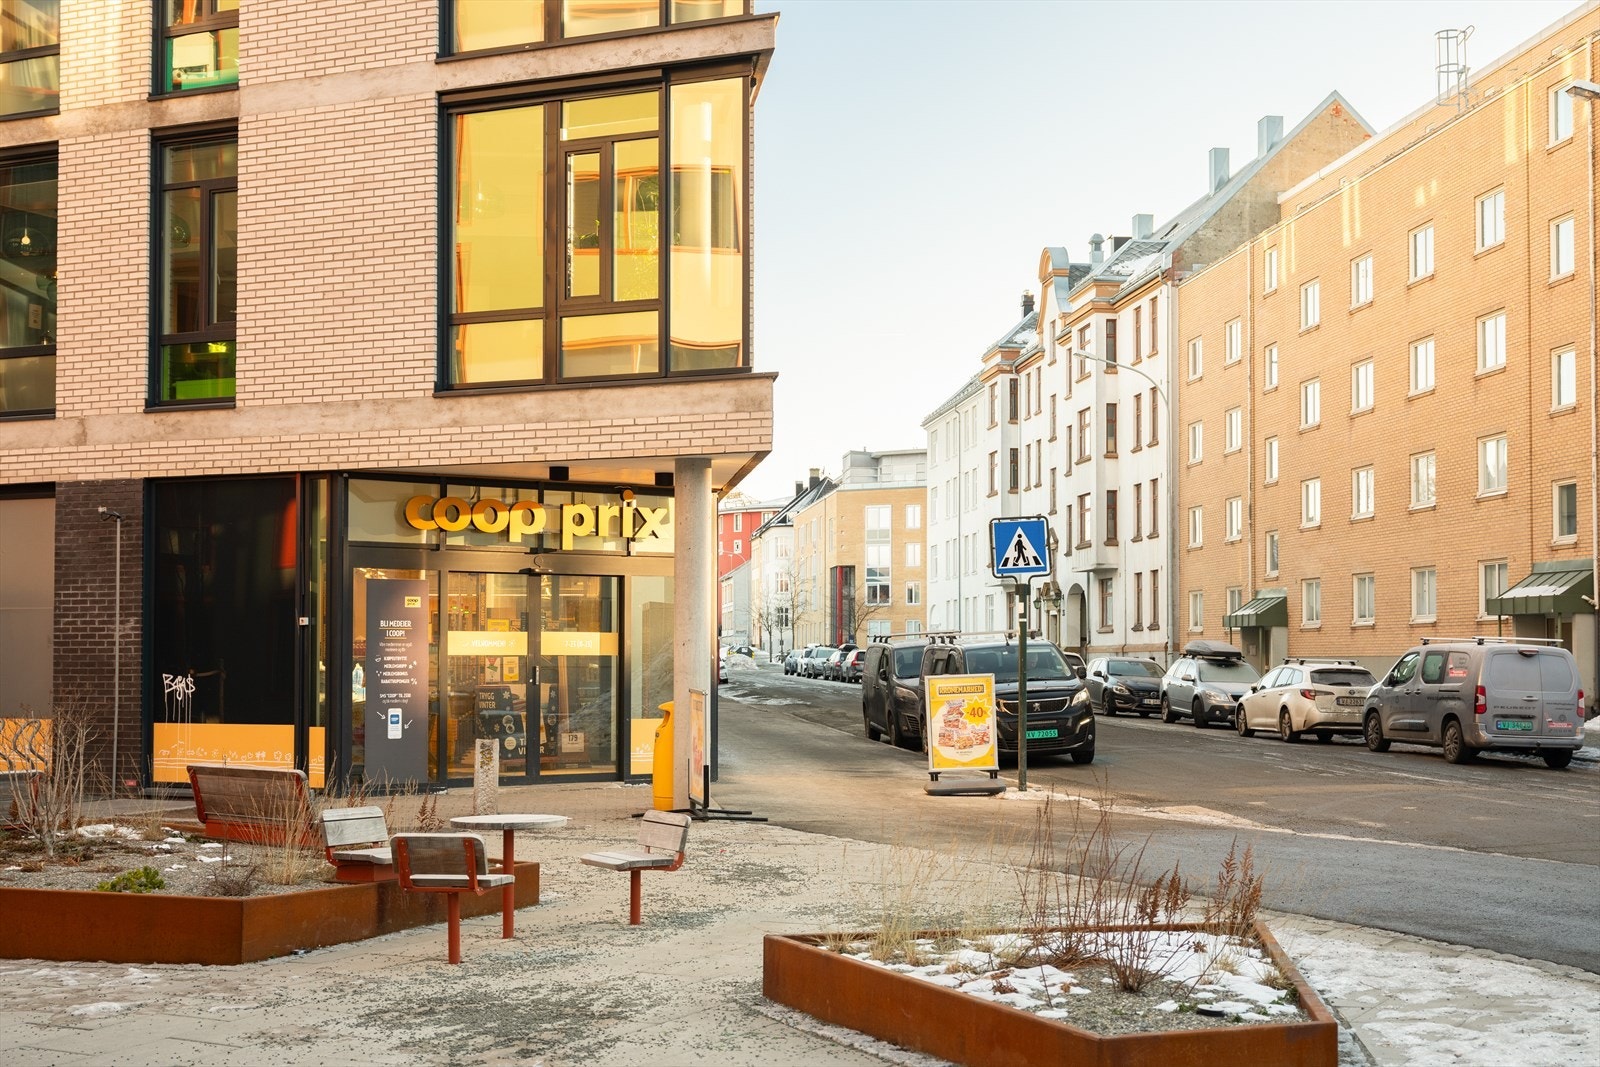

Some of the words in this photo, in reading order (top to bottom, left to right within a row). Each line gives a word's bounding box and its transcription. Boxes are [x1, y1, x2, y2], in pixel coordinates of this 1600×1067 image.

[405, 495, 547, 543] coop
[560, 489, 668, 550] prix
[389, 620, 412, 628] MEDEIER
